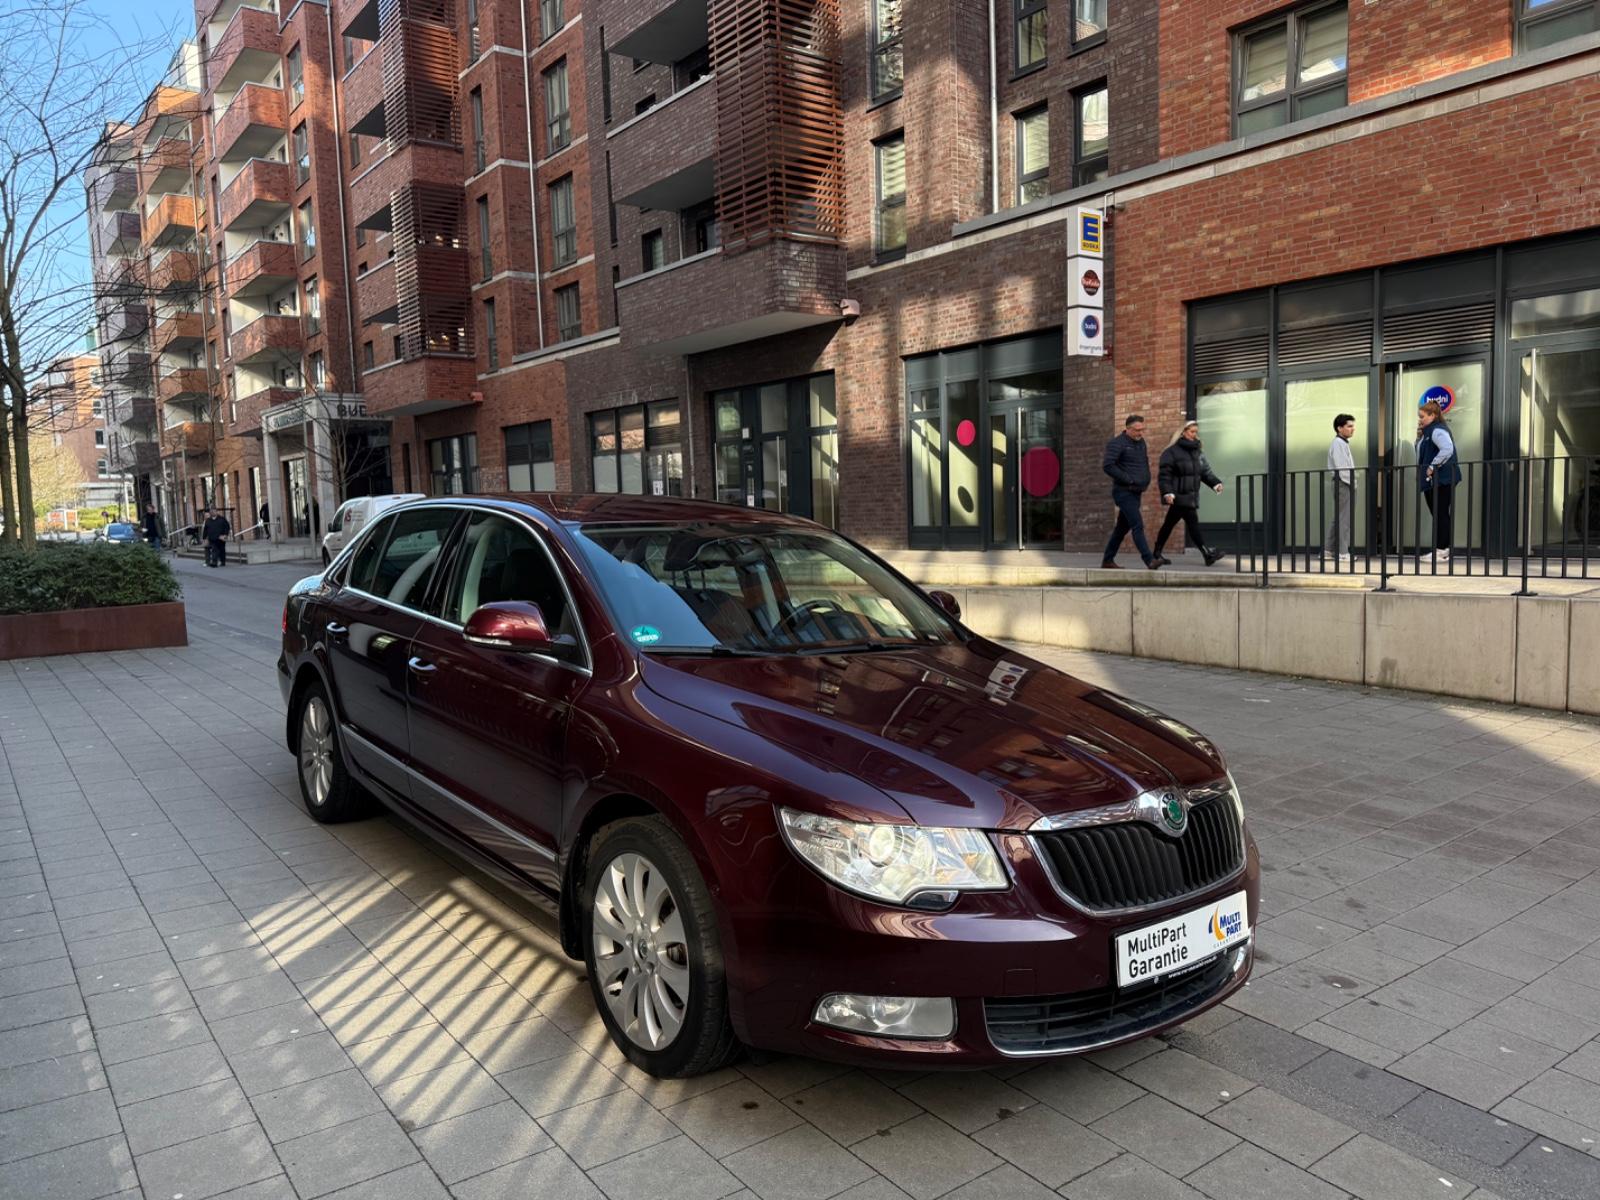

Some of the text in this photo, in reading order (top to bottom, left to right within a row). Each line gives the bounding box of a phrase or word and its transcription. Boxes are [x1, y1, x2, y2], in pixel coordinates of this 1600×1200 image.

[1220, 911, 1240, 930] MULTI
[1226, 921, 1242, 937] PART
[1128, 922, 1187, 957] MultiPart
[1129, 944, 1188, 978] Garantie
